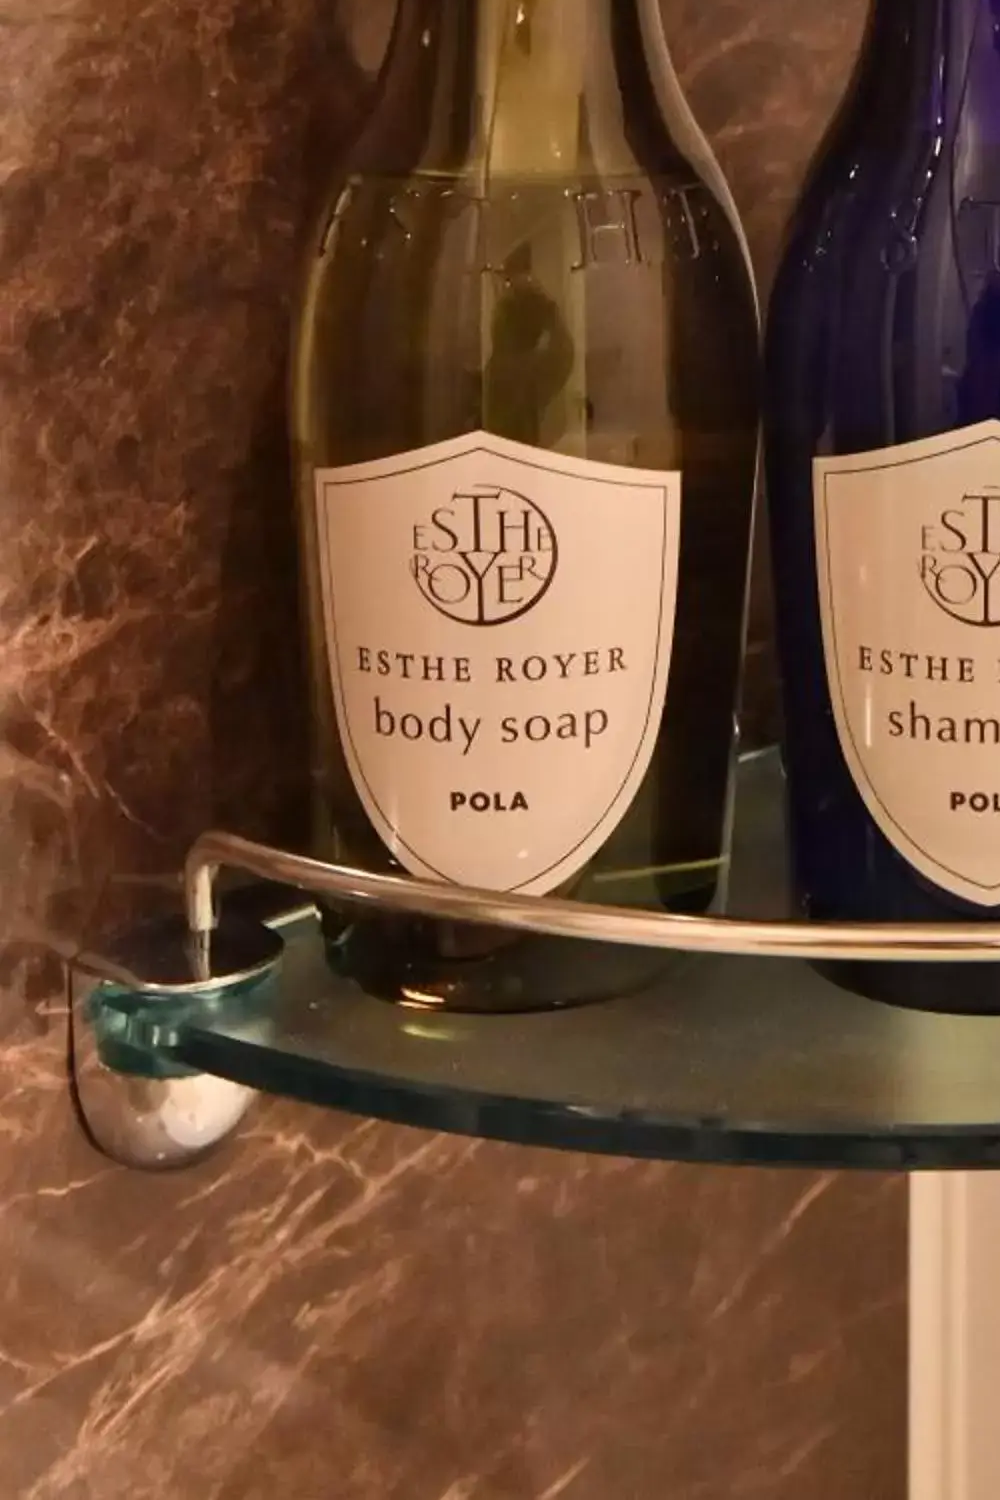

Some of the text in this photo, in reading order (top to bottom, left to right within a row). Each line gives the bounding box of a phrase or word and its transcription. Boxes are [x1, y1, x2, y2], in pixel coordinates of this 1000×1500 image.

[412, 492, 553, 554] ESTHE
[411, 552, 546, 624] ROYER
[357, 646, 628, 683] ESTHE ROYER
[858, 645, 975, 683] ESTHE
[373, 696, 609, 756] body soap
[450, 790, 530, 813] POLA
